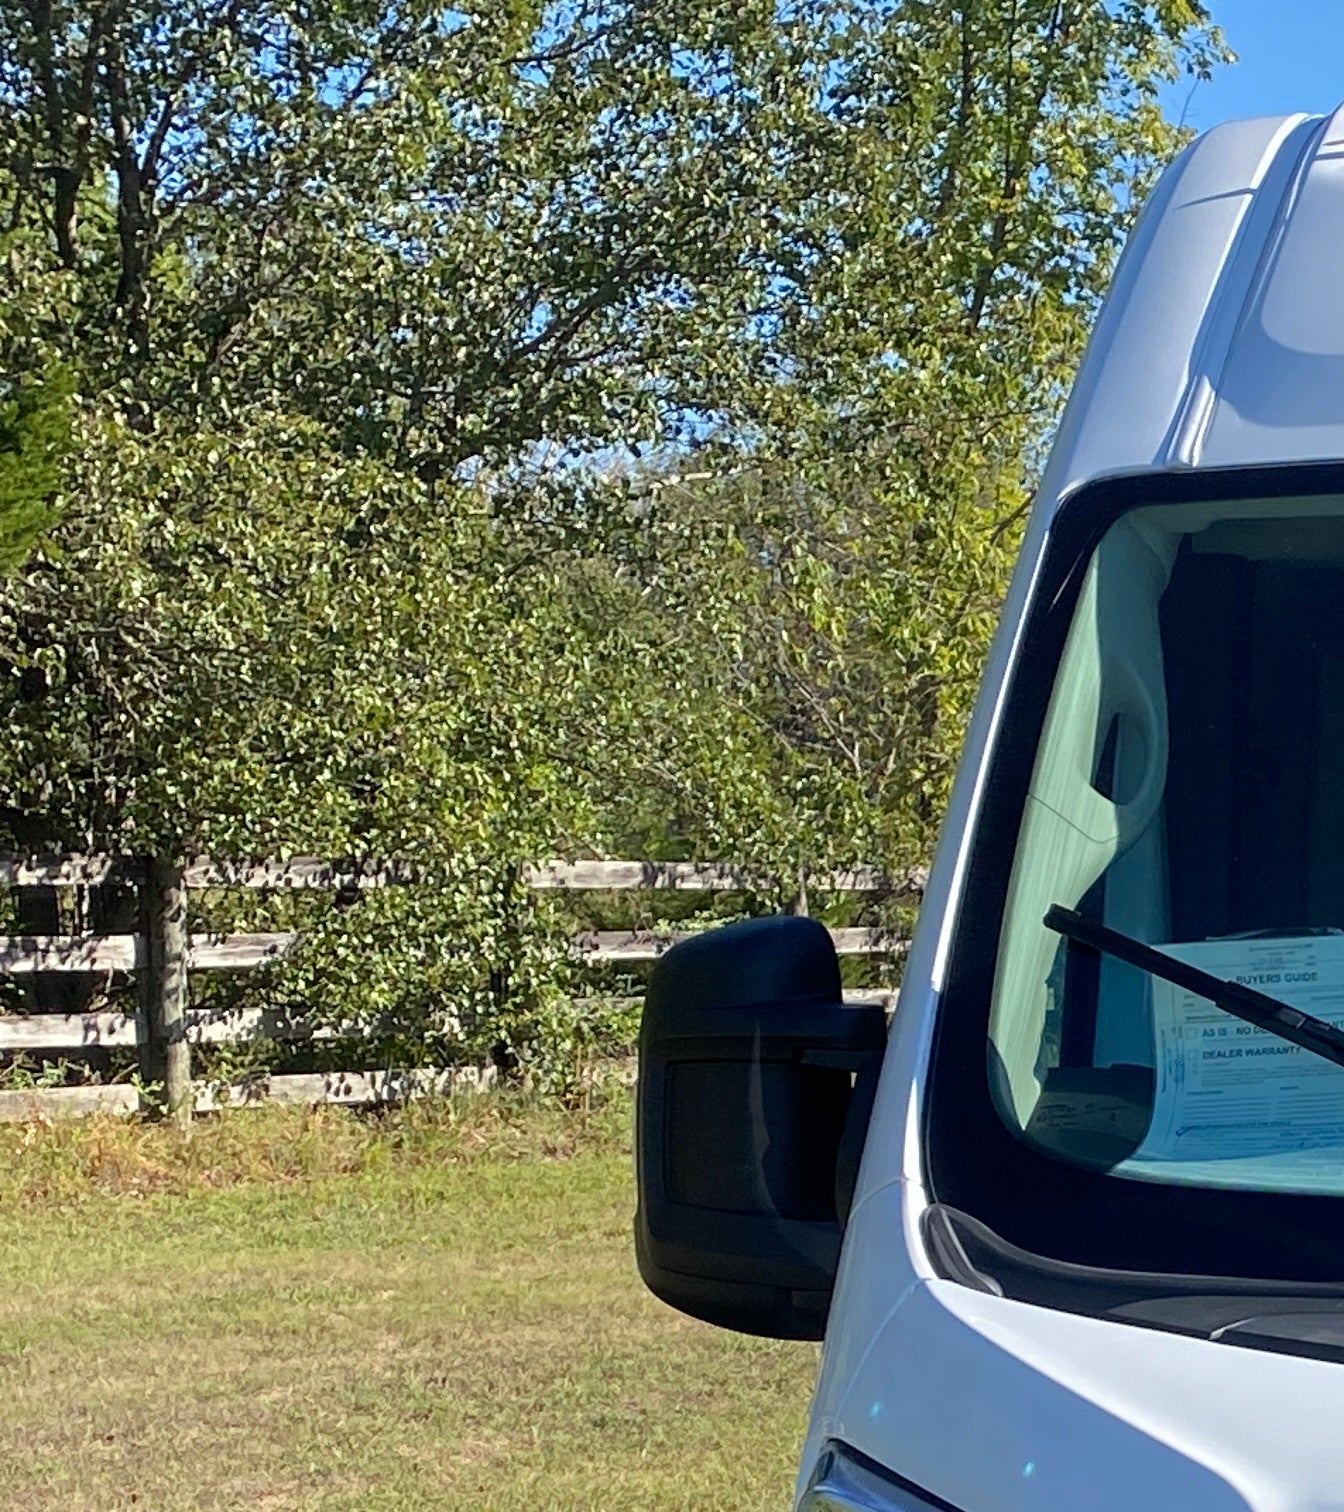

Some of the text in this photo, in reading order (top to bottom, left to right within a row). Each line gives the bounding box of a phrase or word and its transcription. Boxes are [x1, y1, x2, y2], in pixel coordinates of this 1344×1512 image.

[1236, 972, 1318, 985] BUYERS GUIDE
[1202, 1027, 1215, 1037] AS
[1217, 1027, 1228, 1037] IS
[1236, 1026, 1252, 1036] NO
[1202, 1048, 1243, 1060] DEALER
